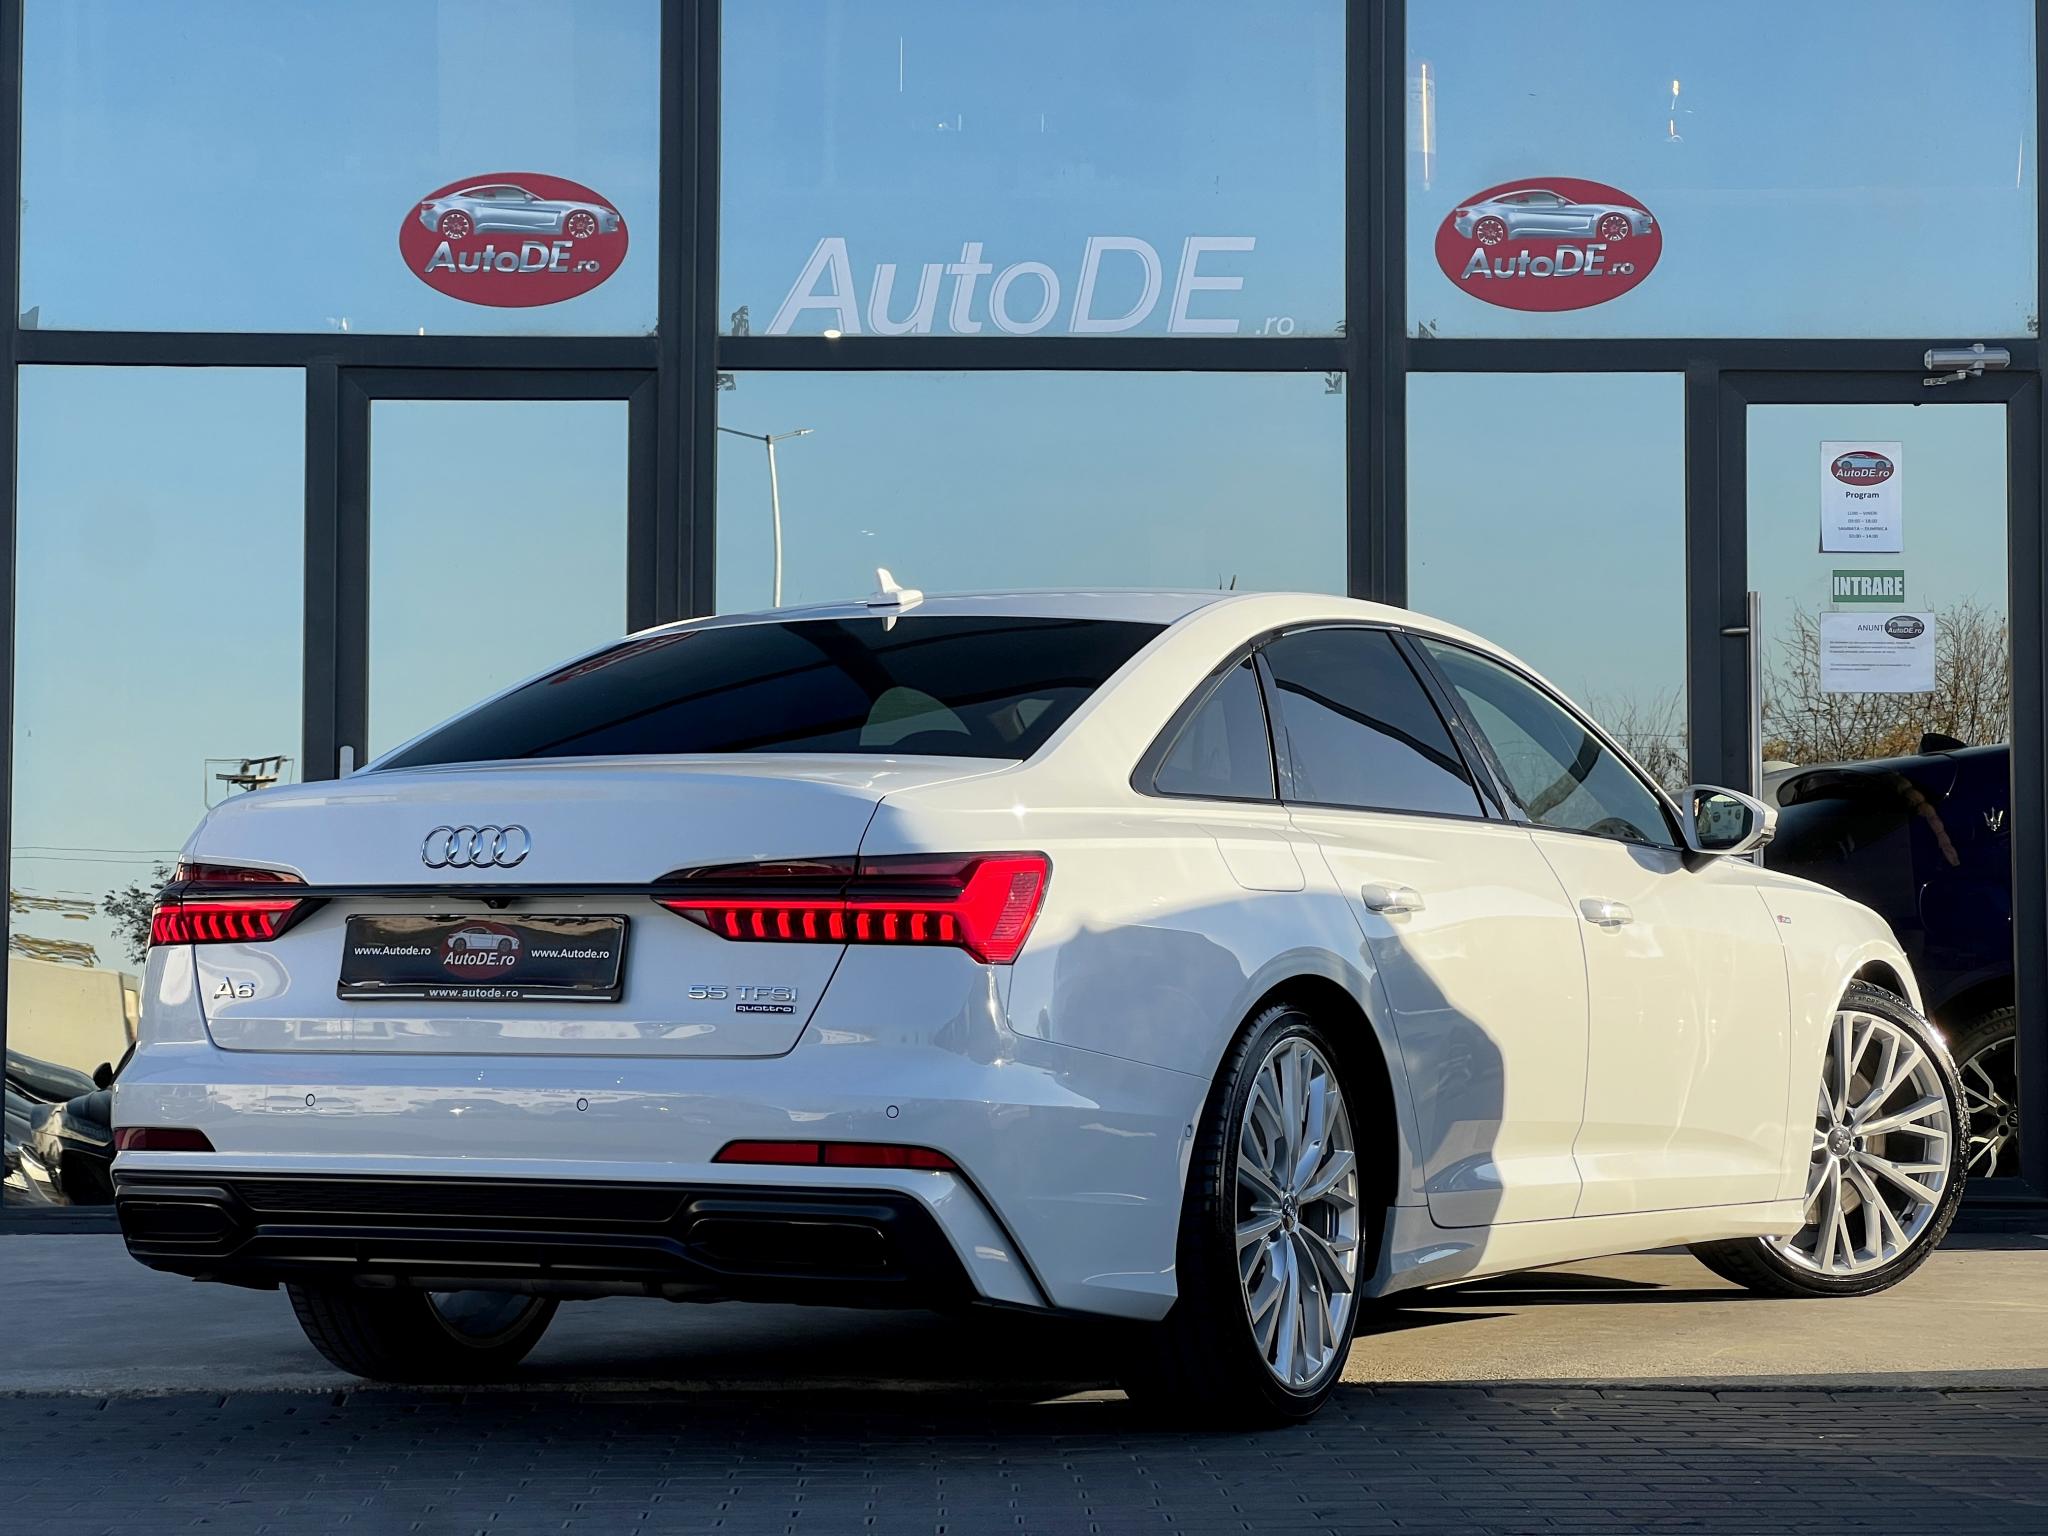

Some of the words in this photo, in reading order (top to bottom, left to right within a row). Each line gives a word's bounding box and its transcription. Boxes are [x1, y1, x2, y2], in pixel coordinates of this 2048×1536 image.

[1836, 468, 1890, 477] AutoDE.ro
[1845, 491, 1880, 500] Program
[1833, 576, 1903, 596] INTRARE
[1857, 624, 1884, 632] ANUNT
[354, 945, 431, 956] www.Autode.ro
[531, 948, 610, 960] www.Autode.ro
[443, 951, 516, 966] AutoDE.ro
[213, 976, 255, 999] A6
[429, 988, 519, 998] www.autode.ro
[688, 984, 728, 1000] 55
[736, 985, 798, 1002] TFSI
[736, 1004, 792, 1012] quattro
